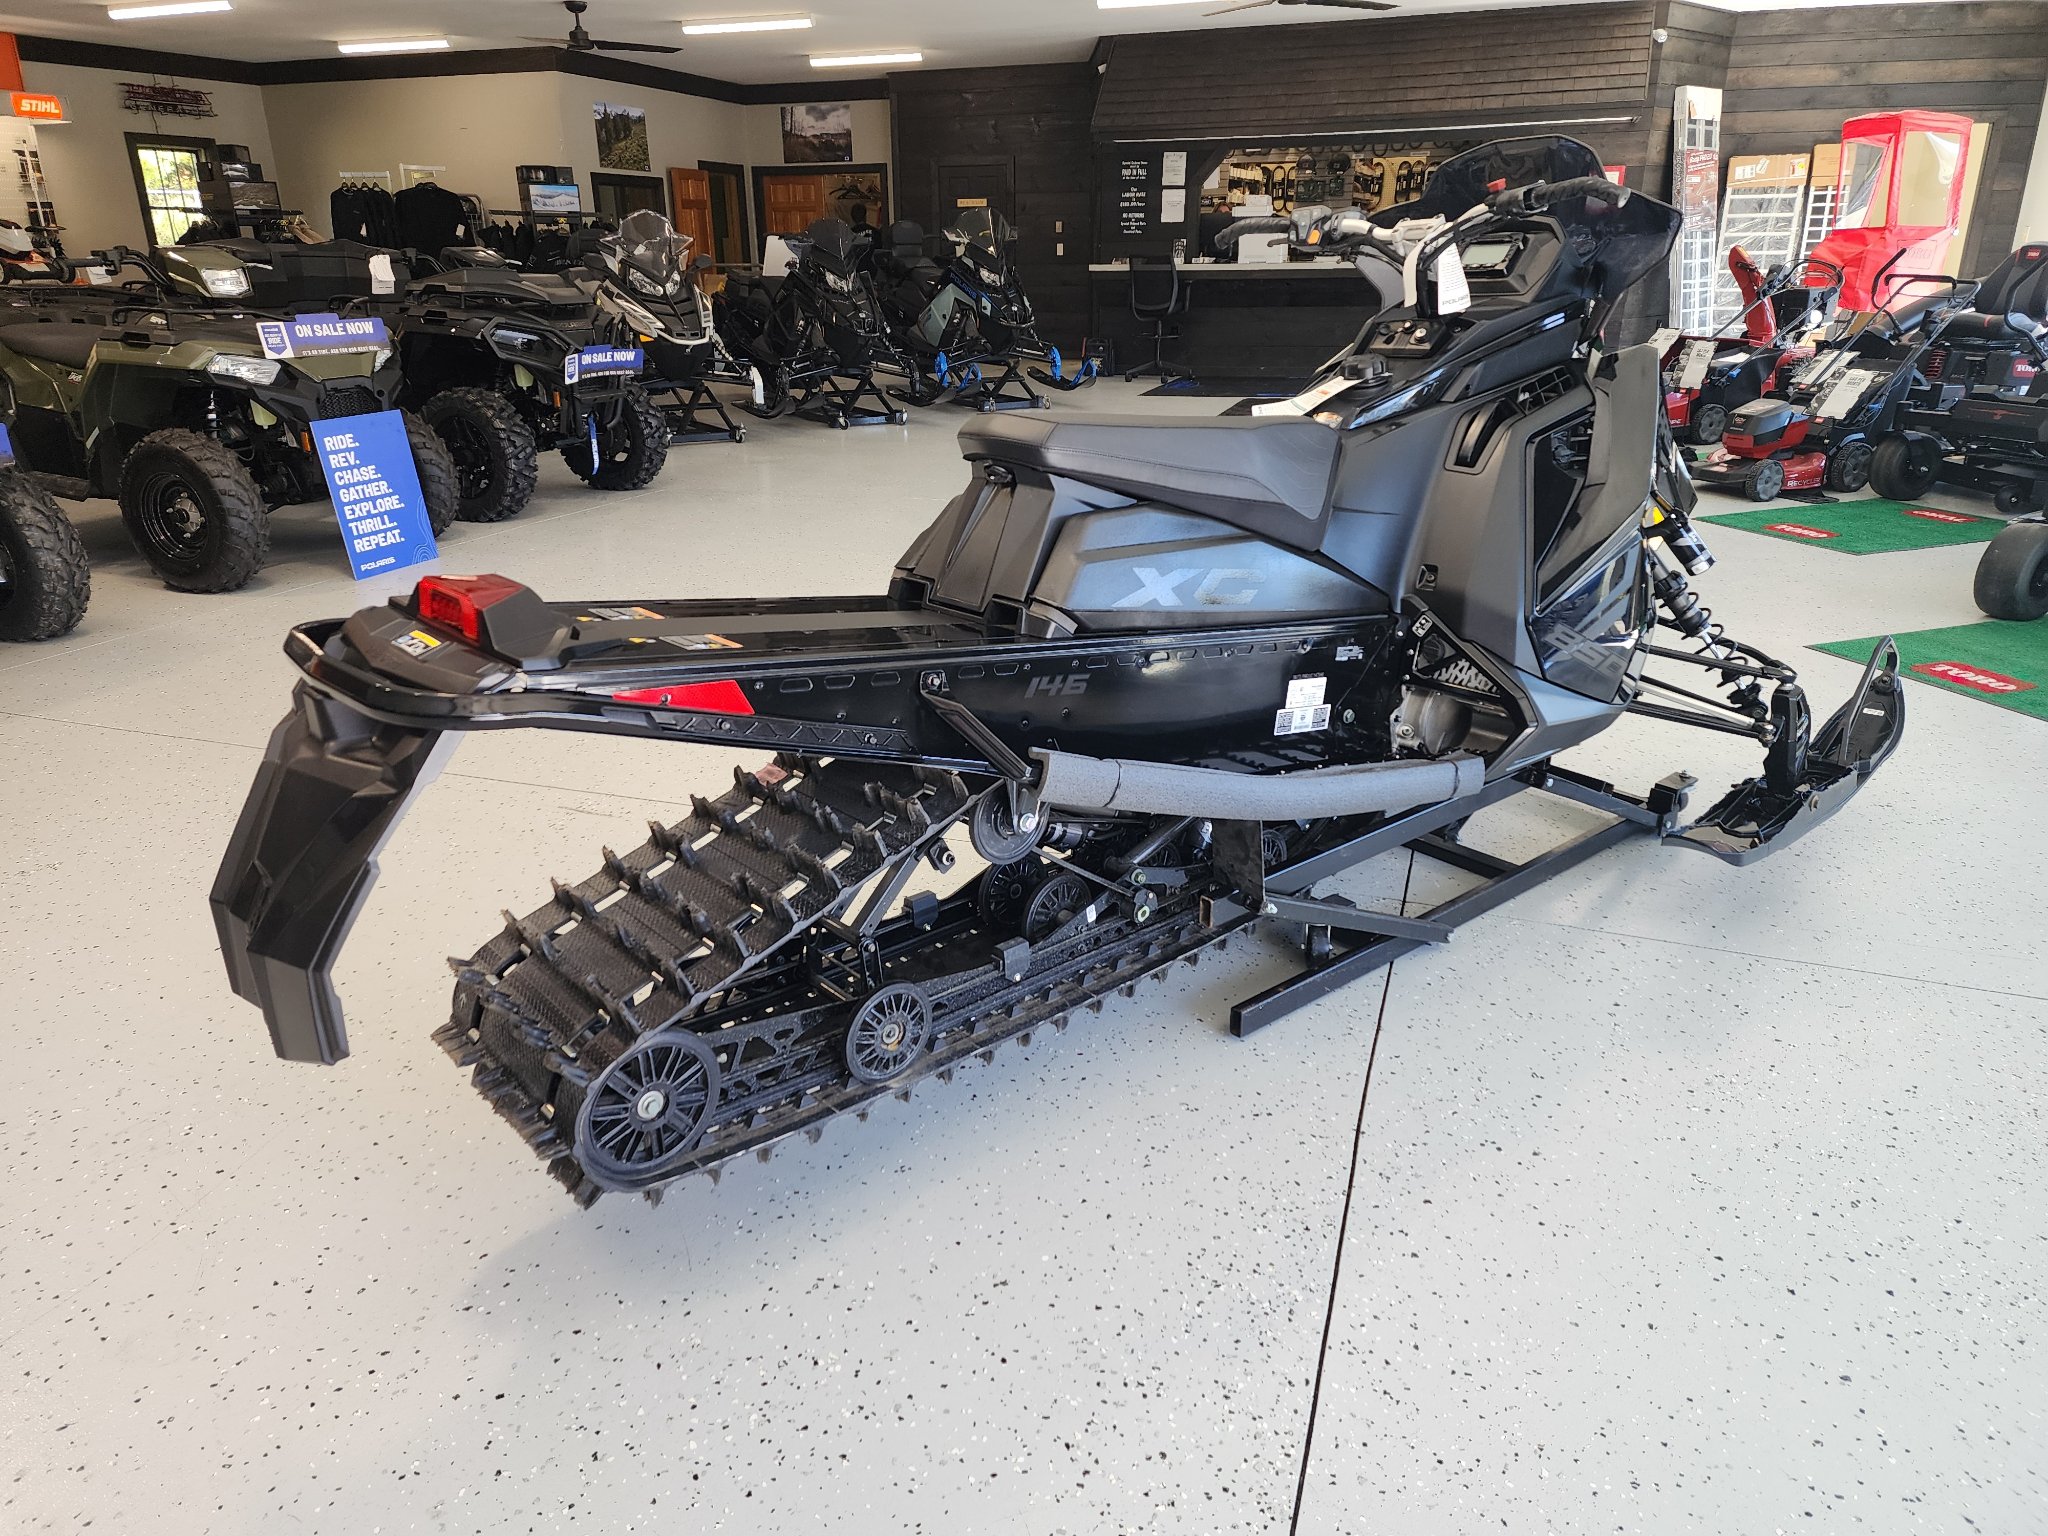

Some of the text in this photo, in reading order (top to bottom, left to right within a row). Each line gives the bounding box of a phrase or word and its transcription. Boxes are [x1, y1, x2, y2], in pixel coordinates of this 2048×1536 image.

[21, 99, 60, 114] STIHL
[1121, 168, 1147, 176] PAID IN FULL
[949, 271, 977, 300] POLARIS
[295, 324, 313, 338] ON
[313, 322, 346, 337] SALE
[345, 321, 374, 334] NOW
[581, 350, 636, 365] ON SALE NOW
[323, 433, 359, 452] RIDE.
[328, 451, 360, 469] REV.
[334, 464, 381, 486] CHASE.
[339, 480, 393, 503] GATHER.
[343, 494, 405, 520] EXPLORE.
[348, 514, 397, 536] THRILL.
[1774, 524, 1828, 538] TORO
[353, 528, 405, 553] REPEAT.
[360, 556, 396, 572] POLARIS
[1111, 567, 1266, 607] XC
[1540, 621, 1629, 681] 850
[1024, 673, 1091, 699] 146
[1929, 663, 2017, 690] TORO
